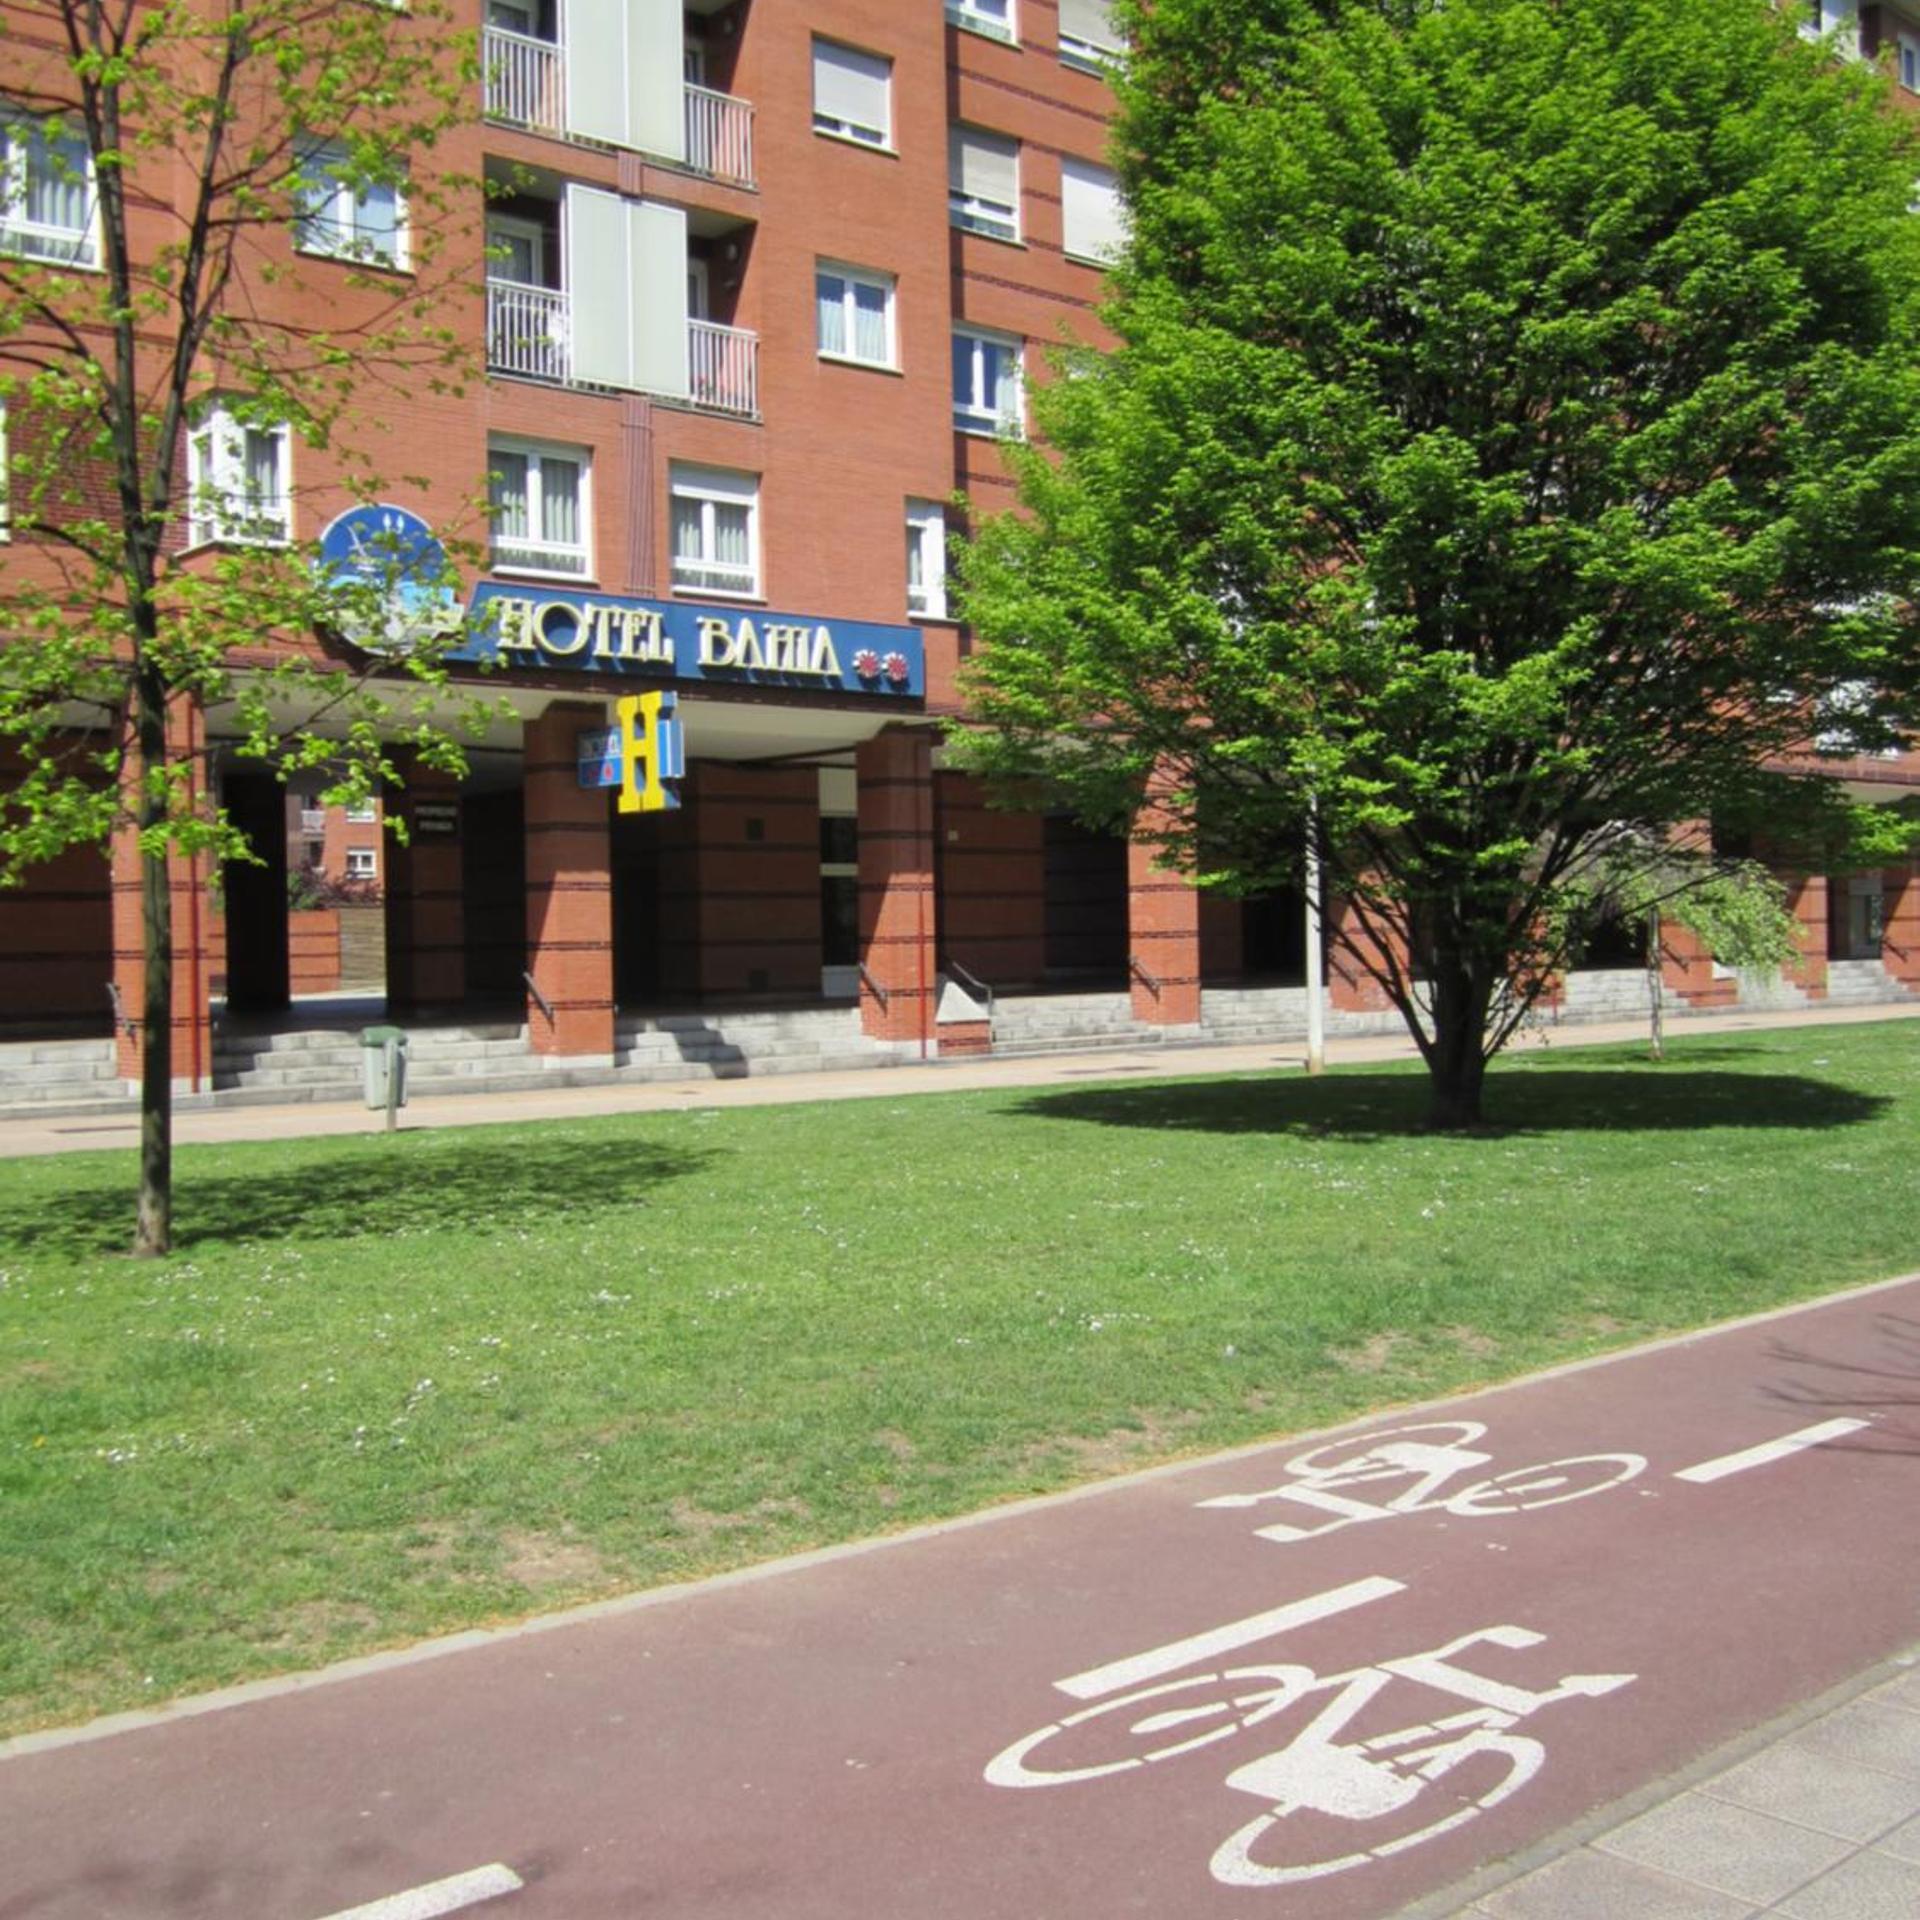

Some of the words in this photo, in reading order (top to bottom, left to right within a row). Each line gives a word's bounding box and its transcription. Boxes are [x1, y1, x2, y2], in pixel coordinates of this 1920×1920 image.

[496, 596, 675, 664] HOTEL
[696, 615, 843, 676] BAHIA
[616, 690, 666, 813] H
